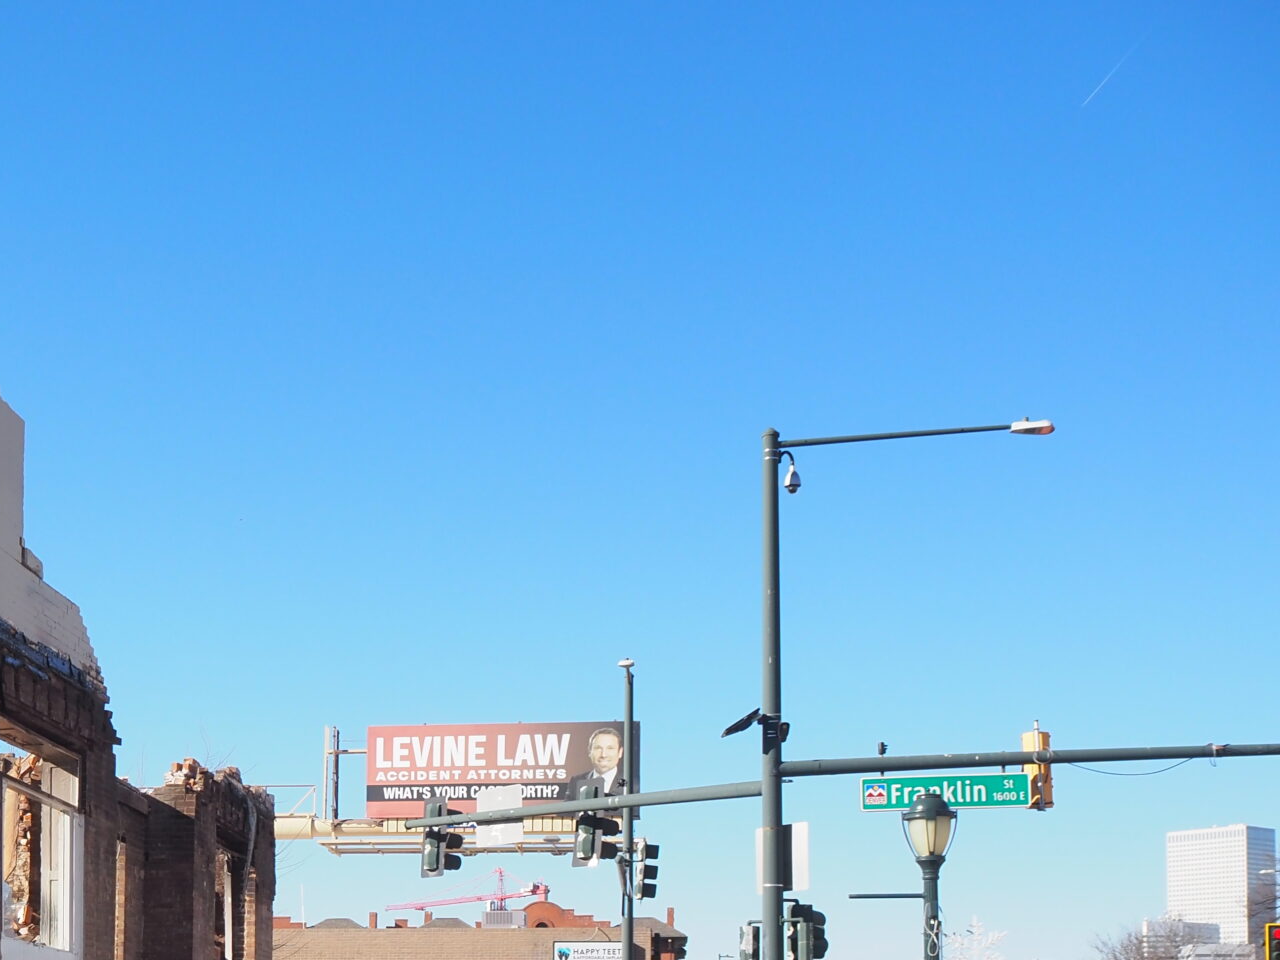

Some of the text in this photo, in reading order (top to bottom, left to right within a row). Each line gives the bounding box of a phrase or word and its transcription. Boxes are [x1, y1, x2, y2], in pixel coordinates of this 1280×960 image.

[376, 733, 571, 768] LEVINE LAW
[375, 768, 567, 782] ACCIDENT ATTORNEYS
[1003, 779, 1014, 789] St
[383, 786, 432, 800] WHAT'S
[434, 785, 468, 799] YOUR
[521, 785, 560, 798] ORTH?
[891, 780, 986, 804] Franklin
[993, 791, 1025, 801] 1600 E
